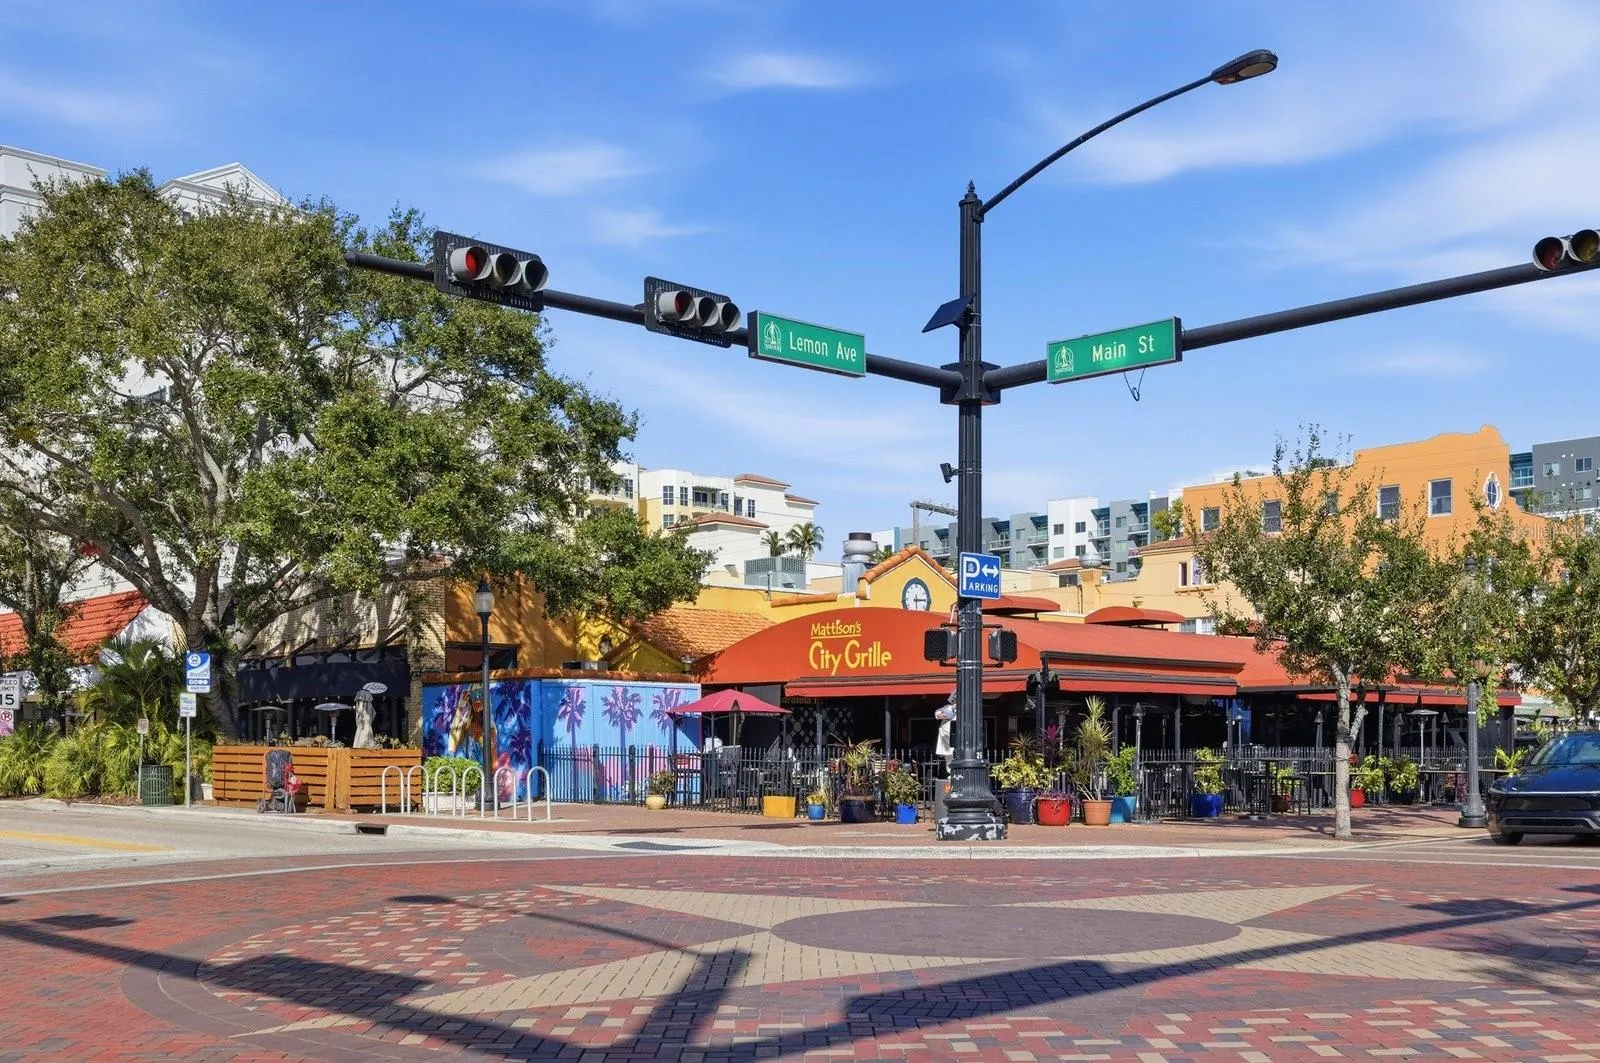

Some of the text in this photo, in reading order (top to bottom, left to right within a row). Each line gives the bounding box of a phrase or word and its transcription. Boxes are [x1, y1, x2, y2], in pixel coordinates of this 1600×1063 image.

[789, 331, 829, 357] Lemon
[836, 341, 857, 363] Ave
[1092, 334, 1154, 363] Main St
[963, 556, 998, 593] PARKING
[810, 619, 862, 637] Mattison's
[809, 639, 892, 676] City Grille
[0, 693, 15, 706] 15
